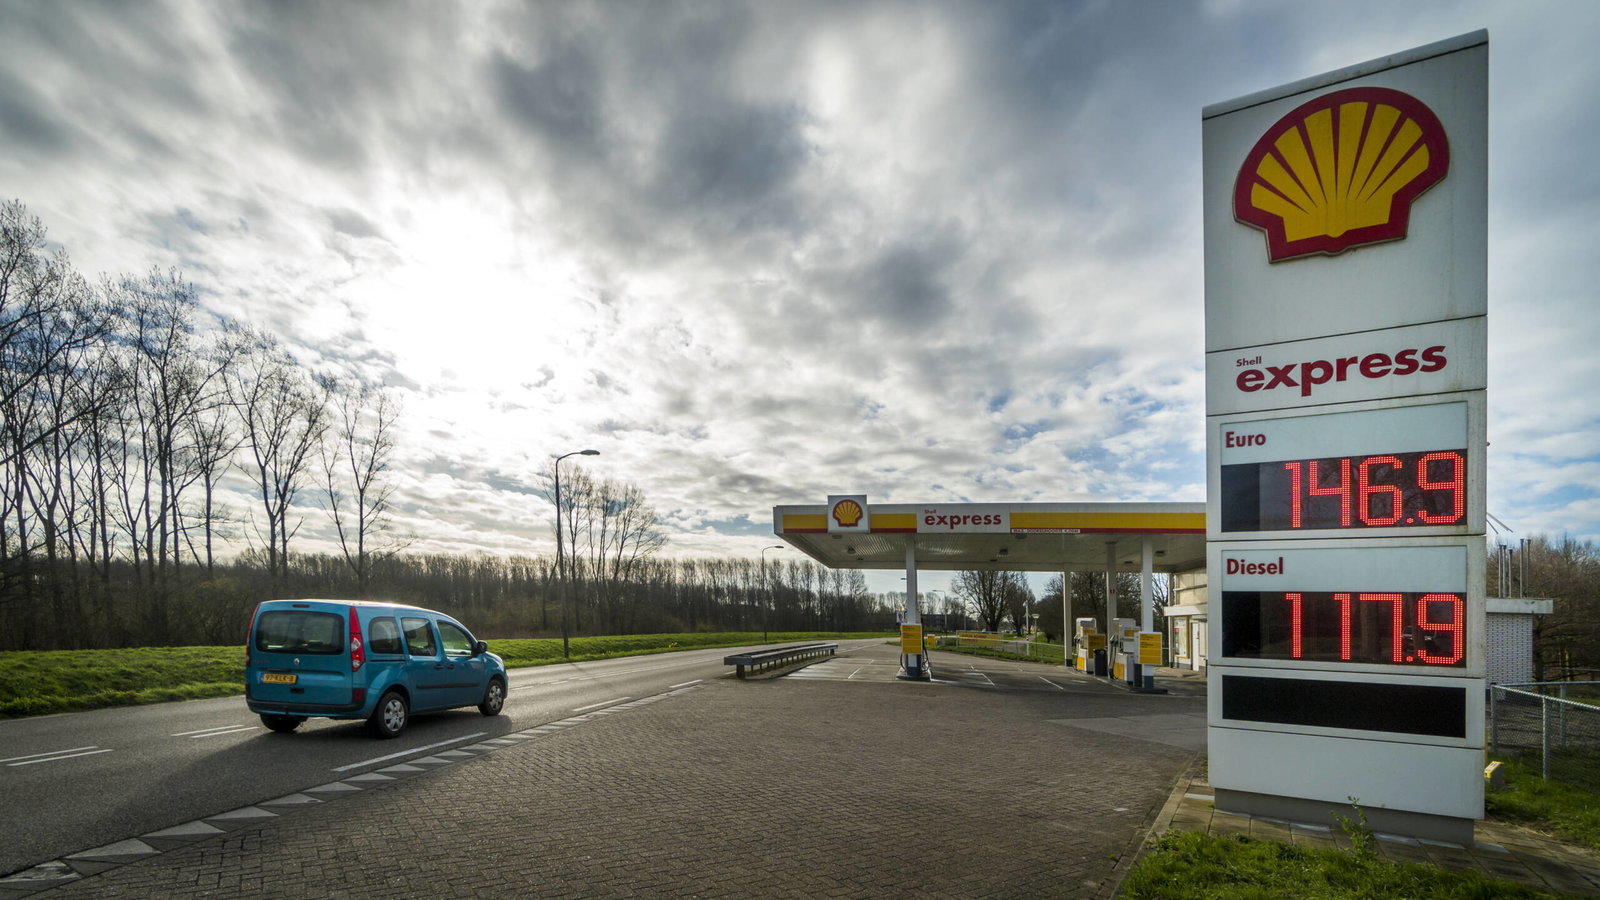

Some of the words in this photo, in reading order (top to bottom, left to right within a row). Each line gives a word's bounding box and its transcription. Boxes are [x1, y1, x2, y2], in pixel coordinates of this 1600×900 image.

[1236, 356, 1262, 367] Shell
[1236, 345, 1448, 397] express
[1225, 431, 1267, 448] Euro
[1285, 452, 1464, 528] 146.9
[924, 514, 1002, 529] express
[1226, 557, 1284, 575] Diesel
[1285, 592, 1463, 664] 117.9
